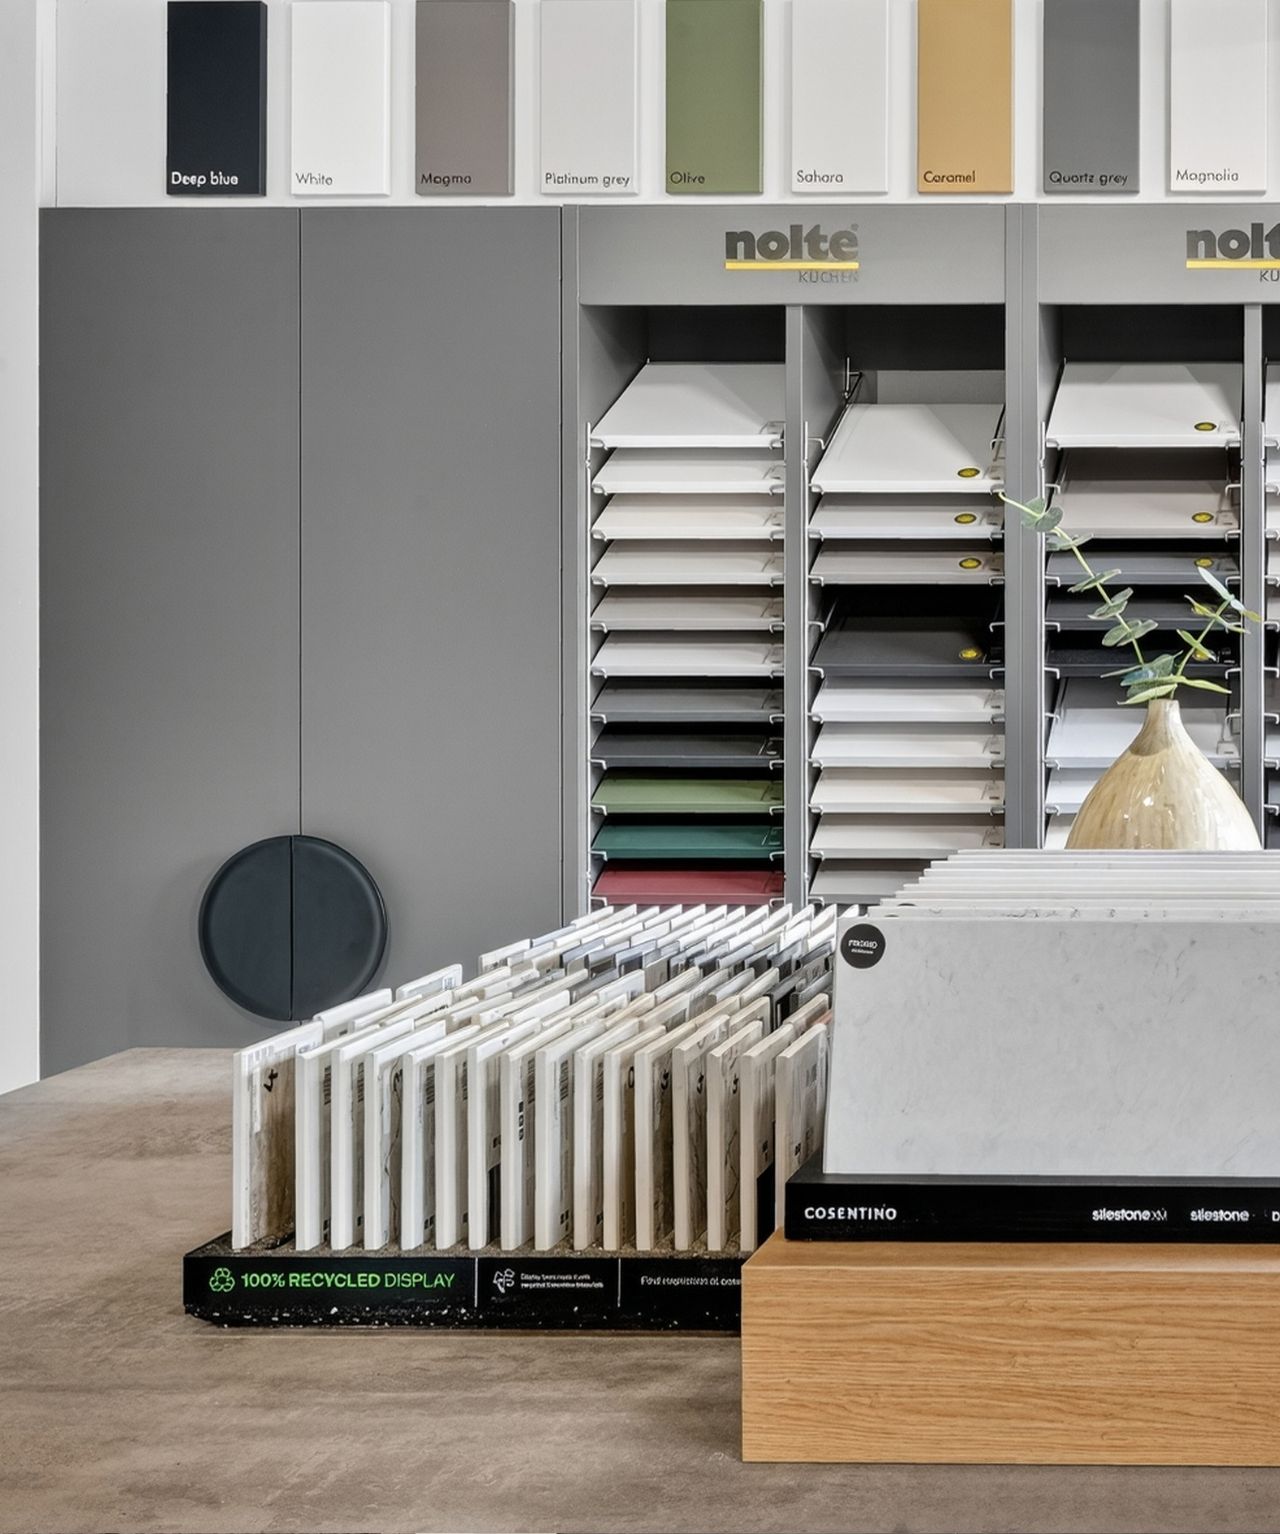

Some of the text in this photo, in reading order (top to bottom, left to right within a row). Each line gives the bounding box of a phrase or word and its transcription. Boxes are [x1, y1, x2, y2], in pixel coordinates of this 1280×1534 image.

[172, 171, 238, 187] Deep blue
[296, 173, 332, 185] White
[421, 173, 471, 187] Magma
[546, 173, 630, 187] Platinum grey
[670, 172, 705, 184] Olive
[797, 170, 843, 183] Sahara
[924, 171, 975, 184] Caramel
[1049, 171, 1127, 186] Quartz grey
[1176, 169, 1238, 184] Magnolia
[725, 224, 858, 261] nolte
[805, 1207, 896, 1220] COSENTINO
[241, 1273, 454, 1288] 100% RECYCLED DISPLAY
